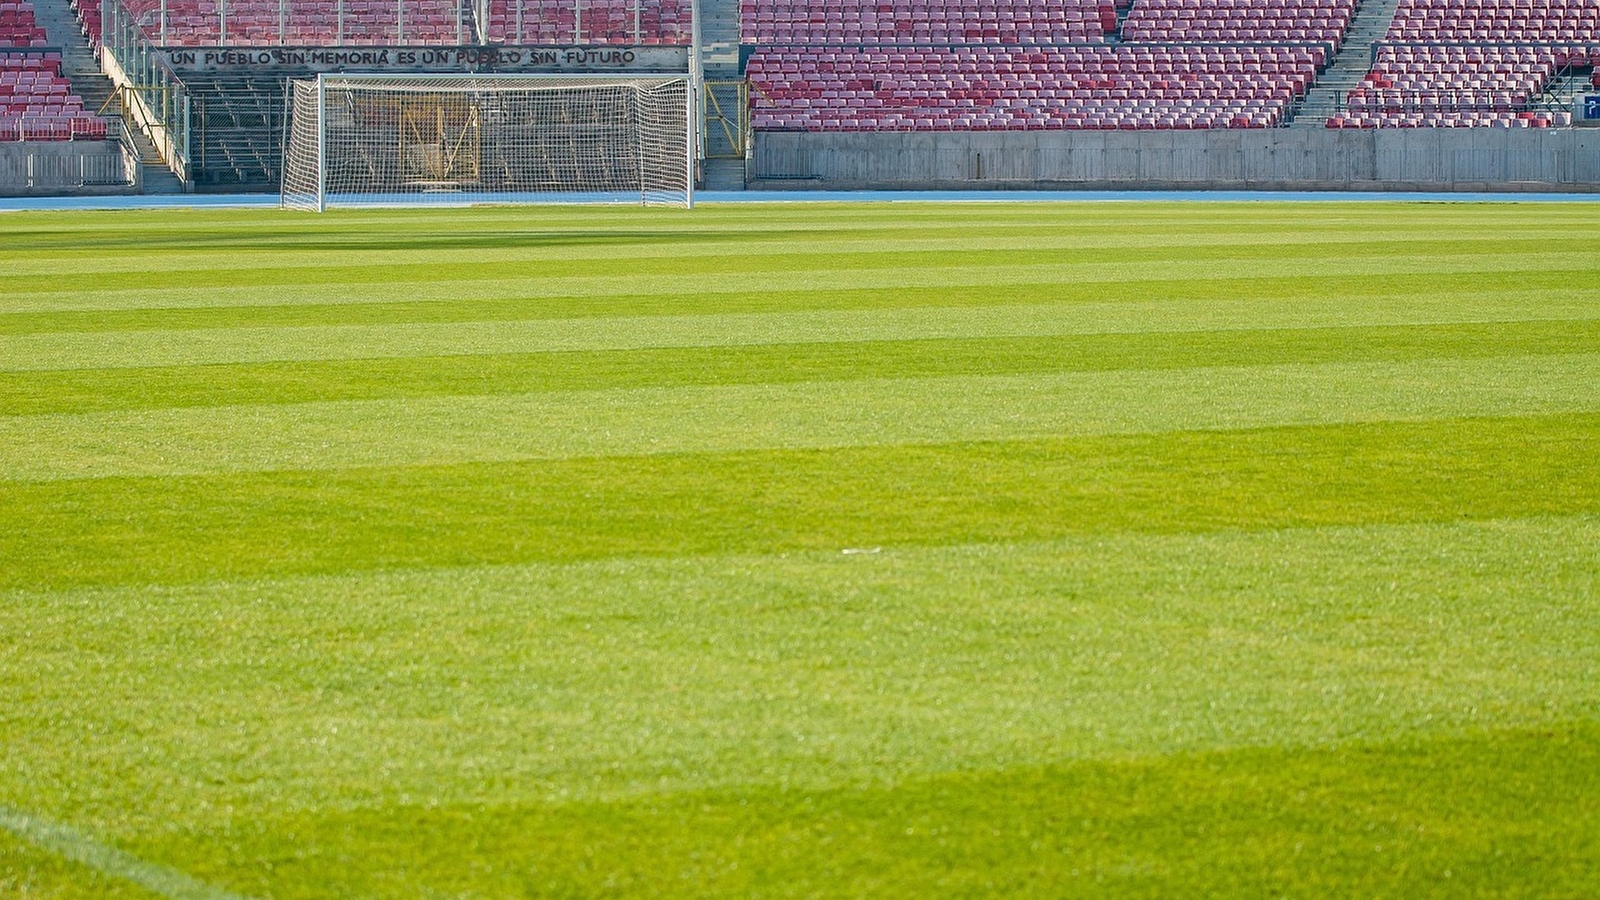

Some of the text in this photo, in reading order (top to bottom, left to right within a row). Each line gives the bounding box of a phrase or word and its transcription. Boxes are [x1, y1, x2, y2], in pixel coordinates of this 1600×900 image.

[171, 53, 195, 64] UN
[205, 53, 271, 64] PUEBLO
[278, 53, 305, 64] SIN
[312, 53, 389, 64] MEMORIA
[398, 53, 416, 64] ES
[422, 52, 448, 63] UN
[530, 52, 557, 63] SIN
[566, 51, 635, 63] FUTURO
